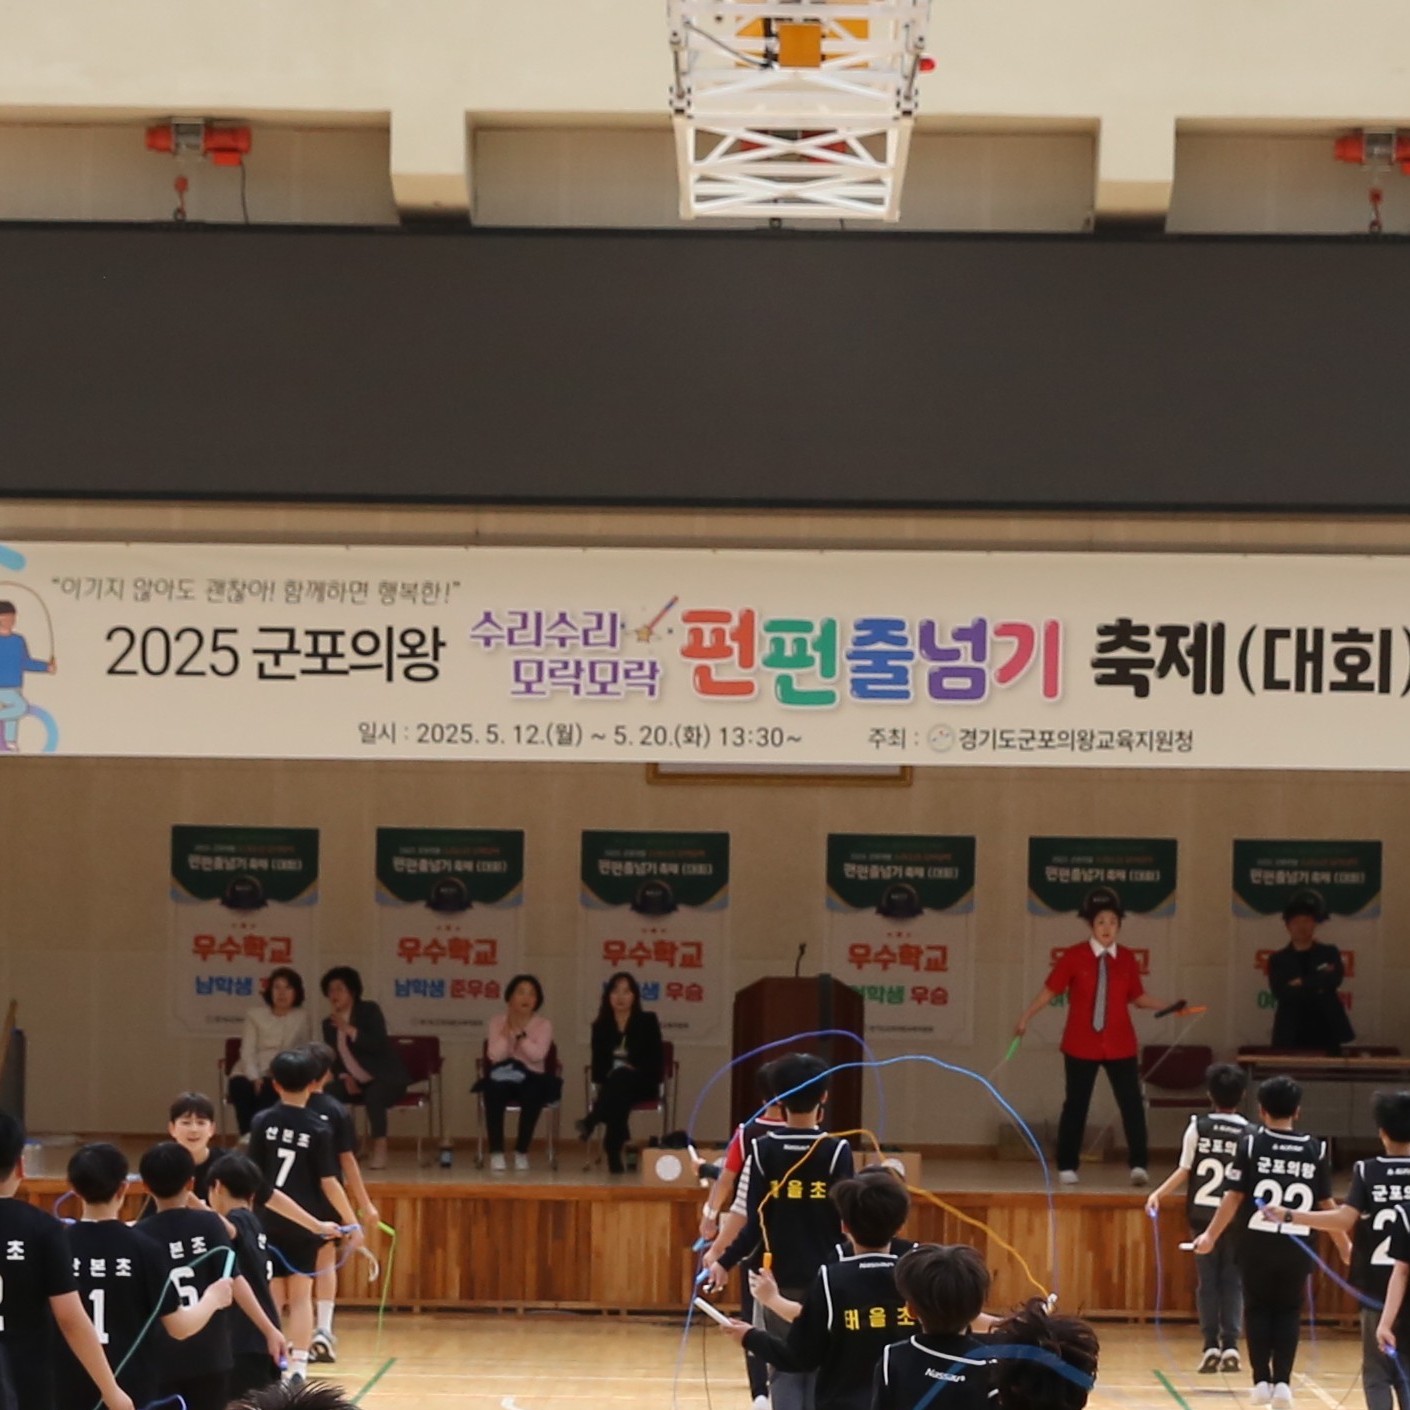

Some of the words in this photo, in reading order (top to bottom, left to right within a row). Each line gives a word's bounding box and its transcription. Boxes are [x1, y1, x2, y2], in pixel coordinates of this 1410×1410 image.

[133, 576, 196, 601] 않아도
[469, 609, 621, 650] 수리수리
[105, 625, 239, 678] 2025
[252, 624, 447, 683] 군포의왕
[510, 657, 662, 698] 모락모락
[358, 721, 396, 745] 일시
[868, 726, 907, 750] 주최
[959, 727, 1194, 753] 경기도군포의왕교육지원청
[192, 933, 293, 964] 우수학교
[397, 936, 498, 966] 우수학교
[602, 939, 703, 969] 우수학교
[848, 943, 948, 972] 우수학교
[1198, 1137, 1238, 1157] 군포의
[275, 1148, 296, 1188] 7
[1257, 1156, 1316, 1180] 군포의왕
[1247, 1179, 1314, 1236] 22
[88, 1288, 110, 1346] 1
